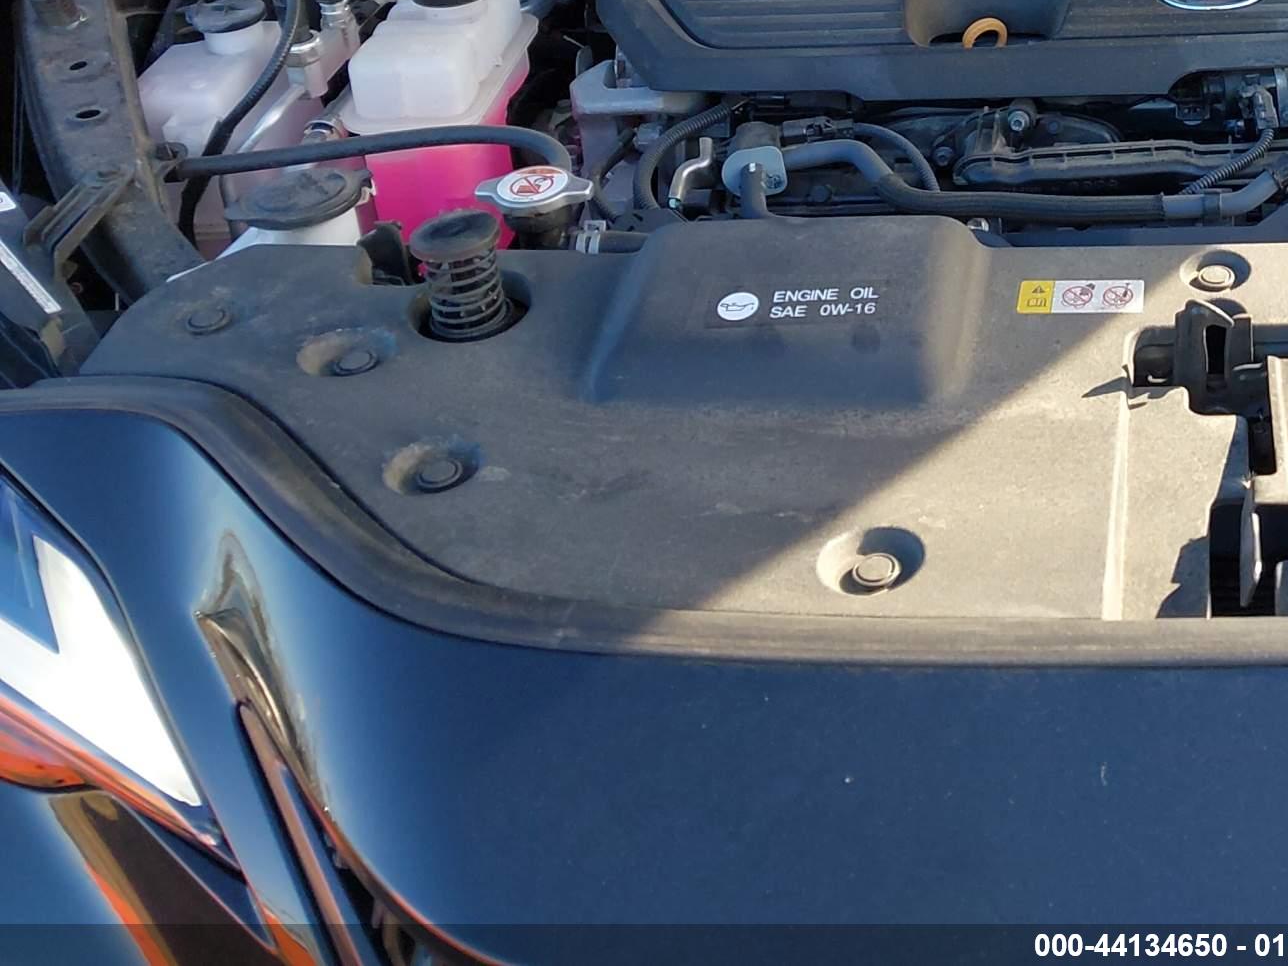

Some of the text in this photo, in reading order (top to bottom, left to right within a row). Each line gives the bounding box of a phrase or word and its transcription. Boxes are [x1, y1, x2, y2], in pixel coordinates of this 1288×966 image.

[773, 286, 879, 303] ENGINE OIL
[769, 302, 876, 319] SAE 0W-16
